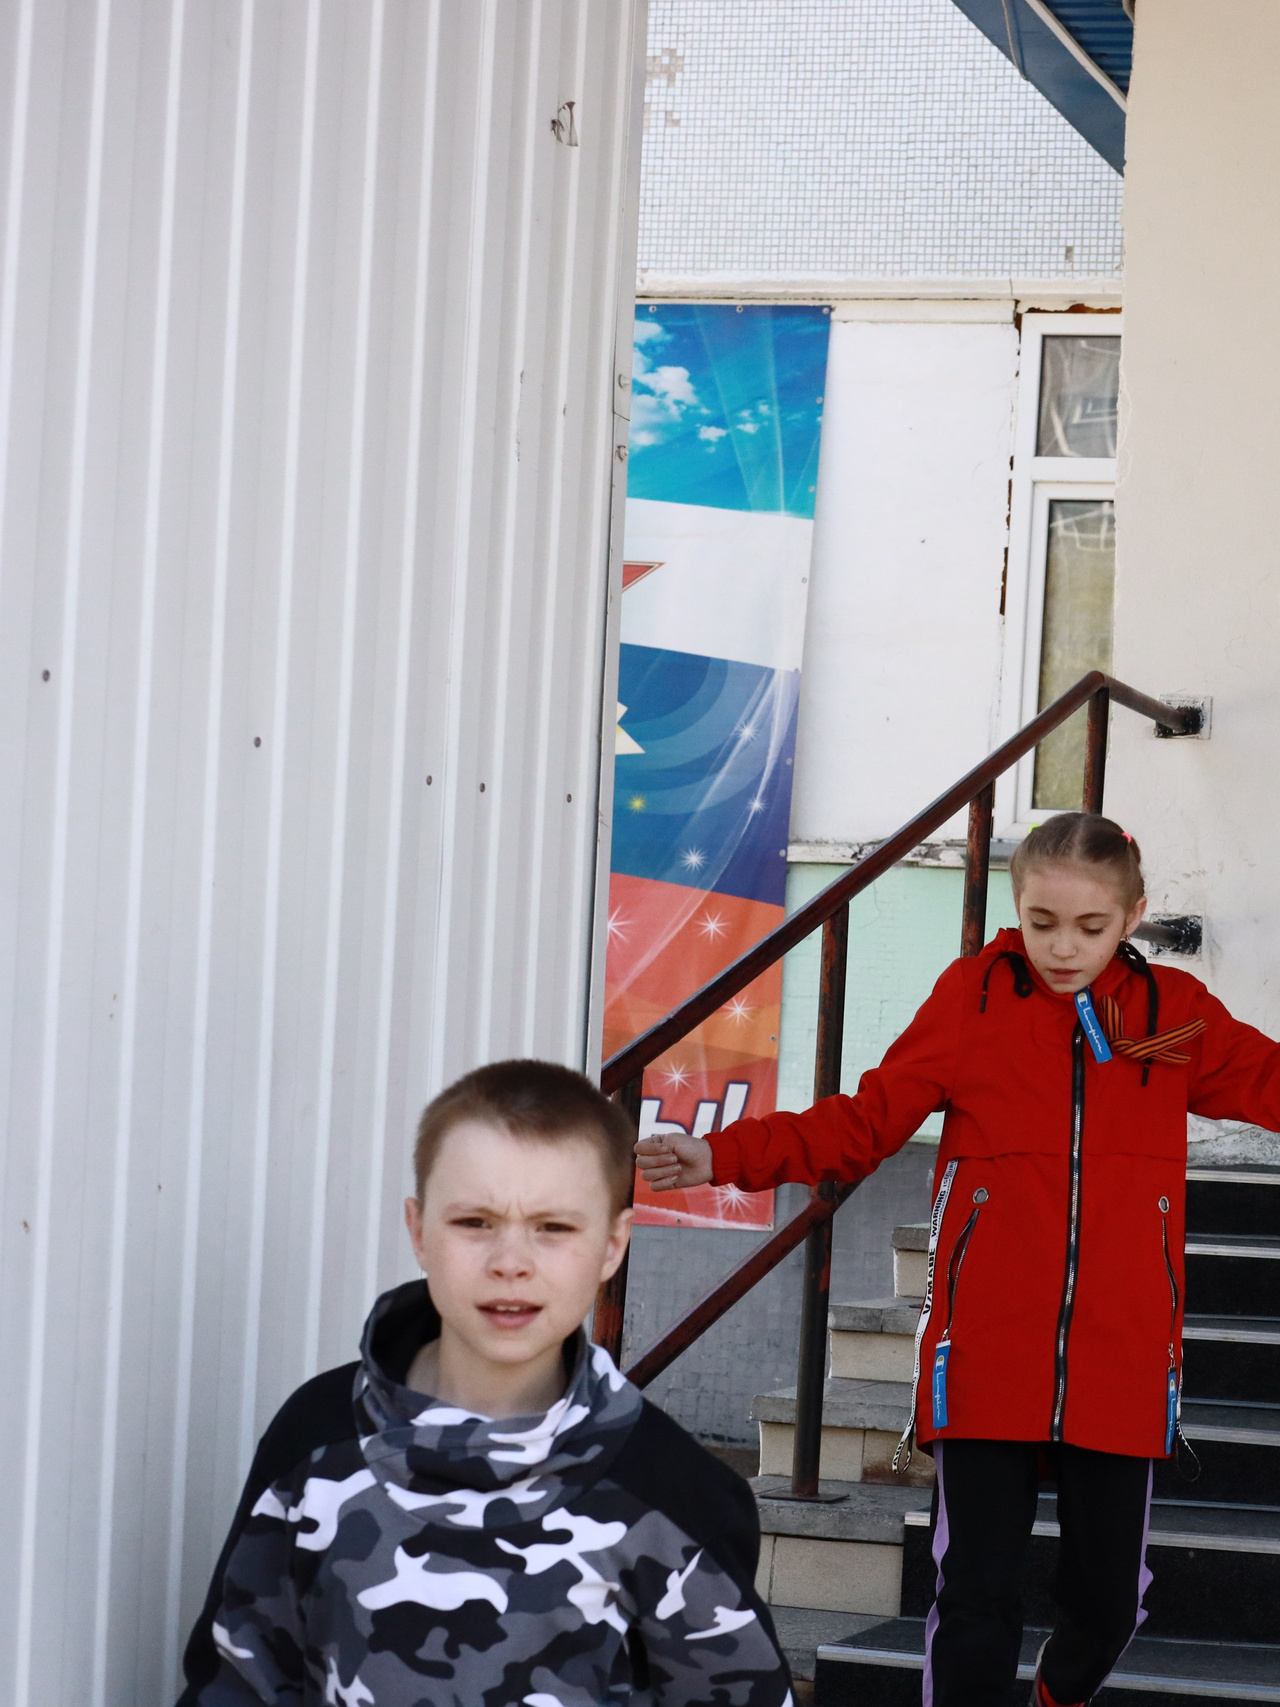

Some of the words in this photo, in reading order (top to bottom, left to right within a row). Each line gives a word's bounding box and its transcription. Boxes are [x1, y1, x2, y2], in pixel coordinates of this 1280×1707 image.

[1077, 992, 1103, 1054] Champion
[931, 1190, 946, 1238] WARNING
[934, 1354, 945, 1421] Champion
